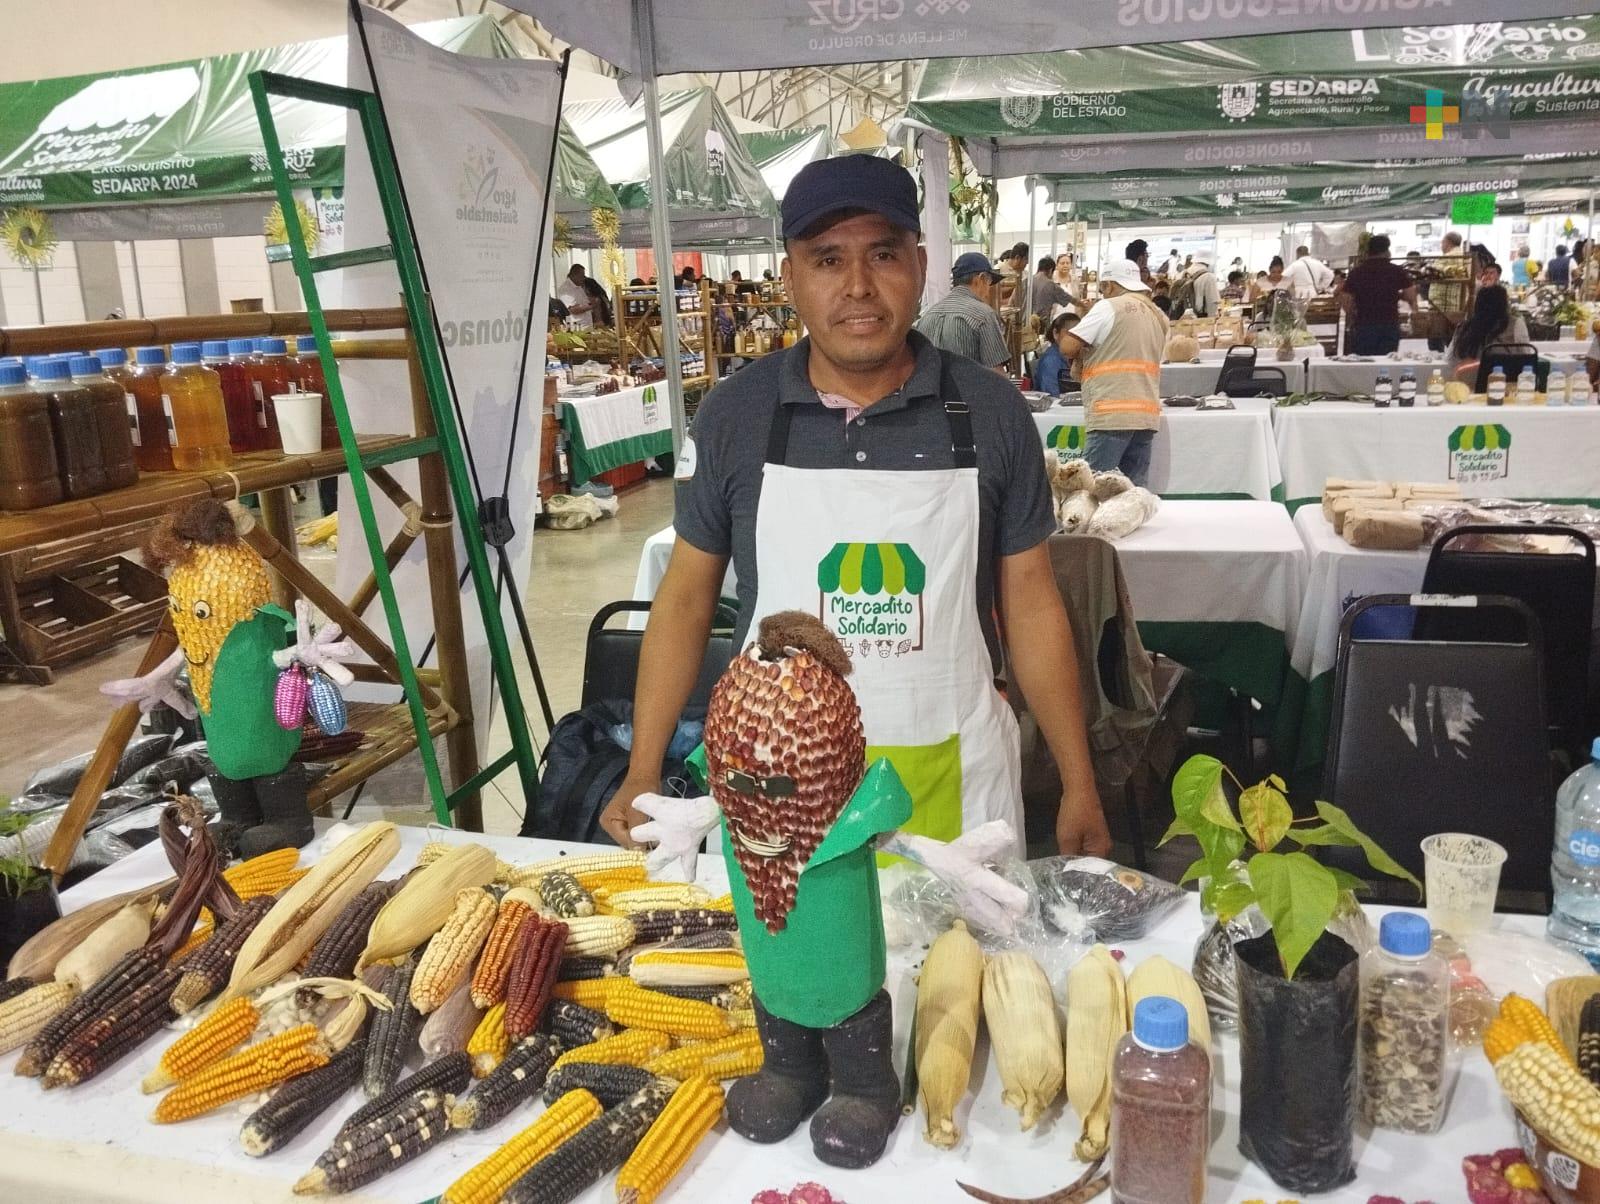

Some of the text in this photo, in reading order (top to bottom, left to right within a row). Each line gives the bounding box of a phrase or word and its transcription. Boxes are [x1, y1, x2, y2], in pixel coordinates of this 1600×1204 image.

[1402, 23, 1587, 44] Soario
[1269, 79, 1380, 96] SEDARPA
[1053, 95, 1116, 106] GOBIERNO
[1327, 95, 1373, 104] Desarrollo
[1053, 106, 1126, 118] DEL ESTADO
[1268, 104, 1390, 116] Agropecuario, Rural y Pesca
[33, 122, 151, 150] Mercadito
[283, 155, 315, 172] RUZ
[93, 174, 198, 194] SEDARPA 2024
[1431, 179, 1518, 195] AGRONEGOCIOS
[1322, 185, 1390, 200] Agricultura
[1056, 450, 1084, 458] ercad
[1455, 450, 1503, 461] Mercadito
[1459, 462, 1498, 473] Solidario
[831, 596, 913, 614] Mercadito
[838, 616, 907, 635] Solidario
